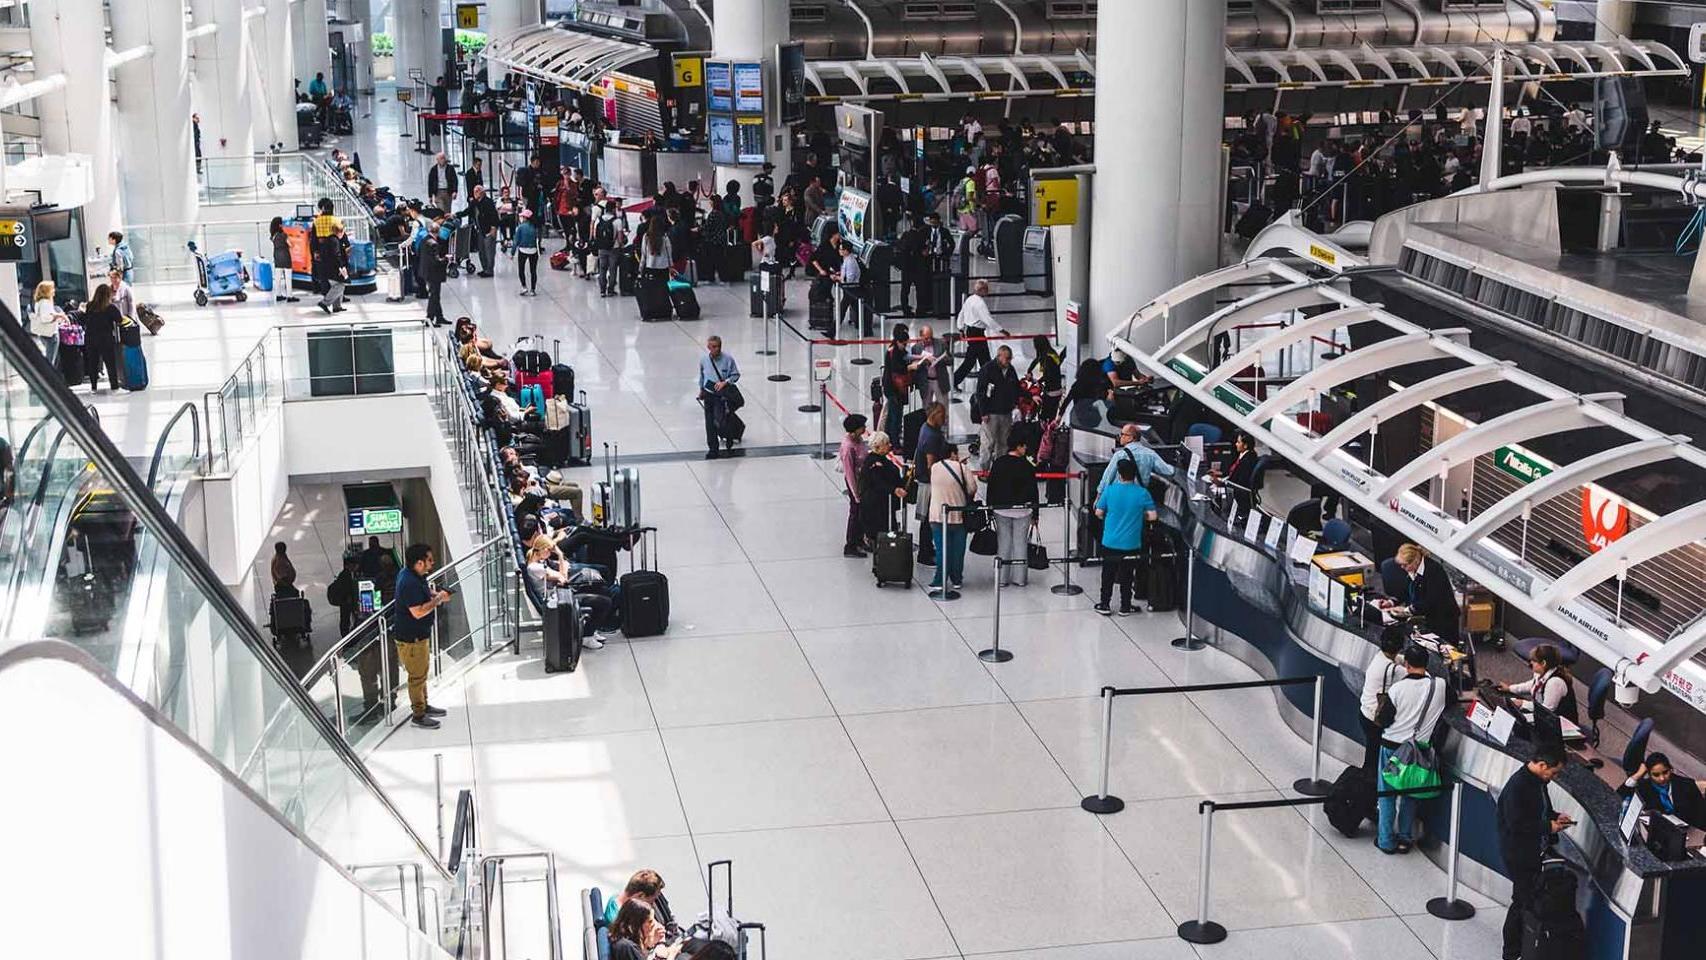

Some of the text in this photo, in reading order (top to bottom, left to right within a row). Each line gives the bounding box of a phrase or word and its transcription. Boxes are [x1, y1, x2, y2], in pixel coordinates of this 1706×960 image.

[682, 71, 692, 83] G
[1046, 200, 1057, 219] F
[1503, 451, 1534, 478] Alitalia
[367, 519, 398, 529] CARDS
[370, 512, 388, 521] SIM
[1400, 506, 1438, 535] JAPAN AIRLINES
[1557, 605, 1608, 641] JAPAN AIRLINES
